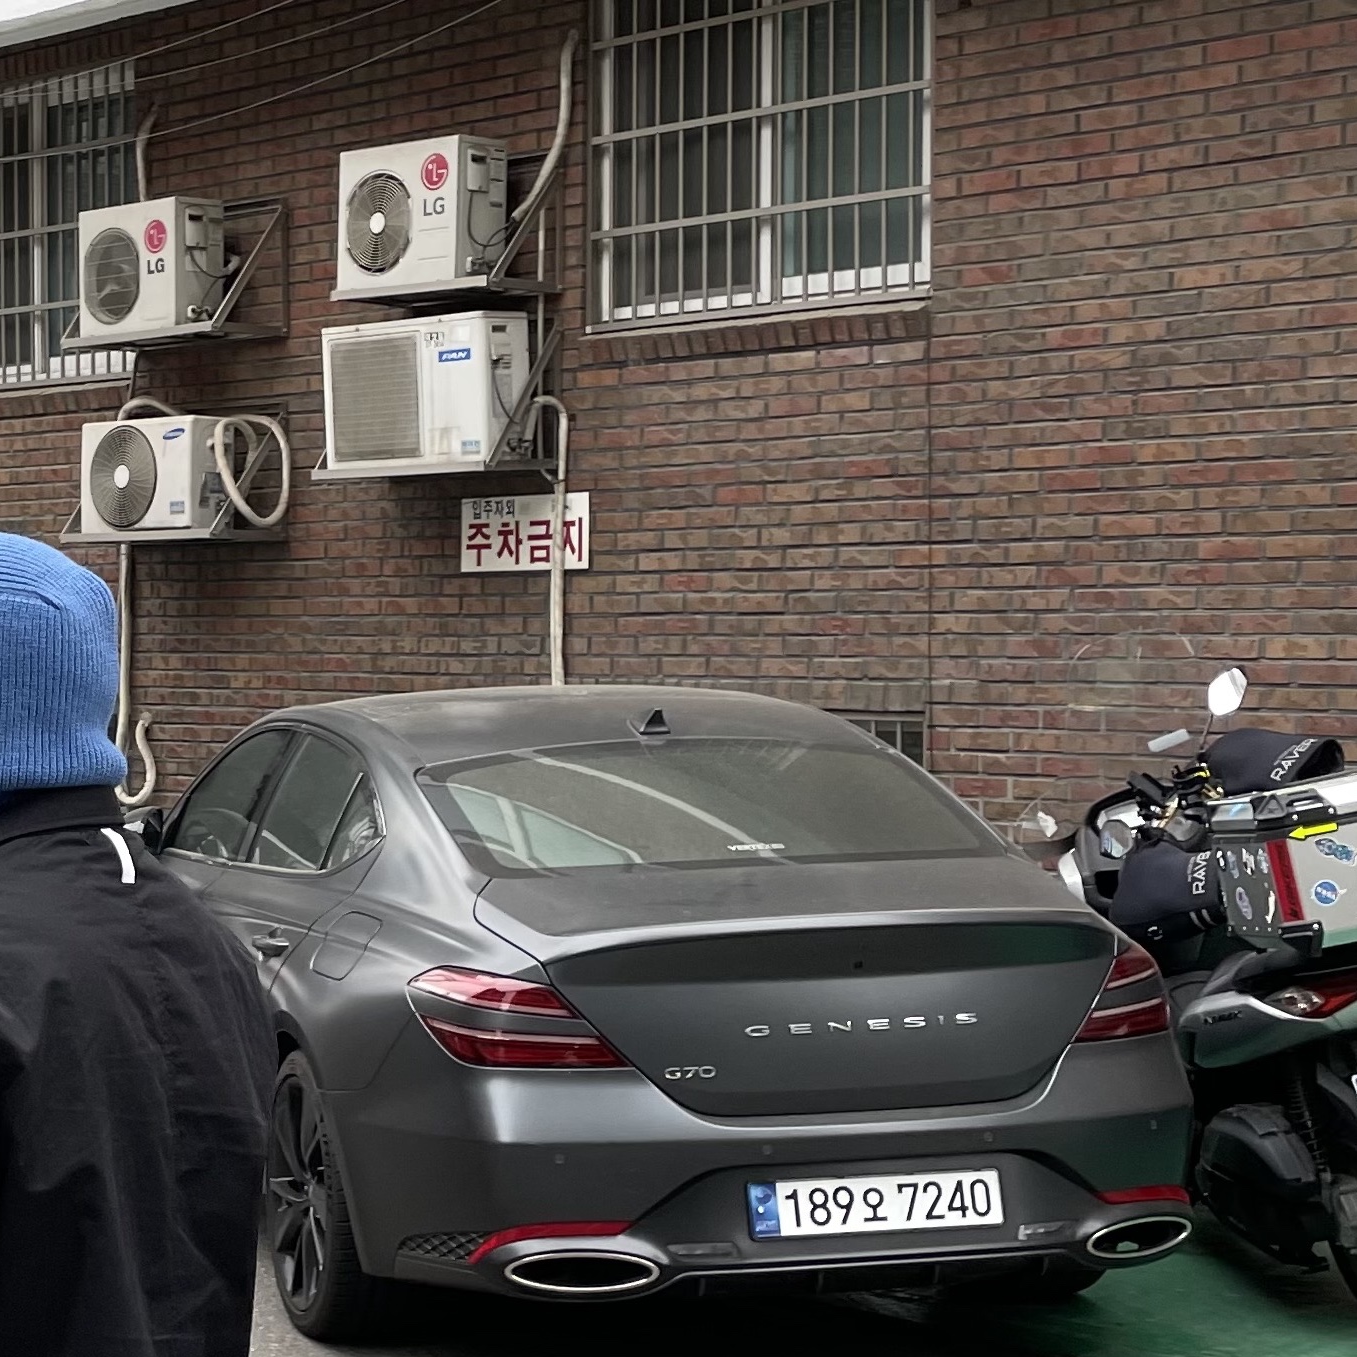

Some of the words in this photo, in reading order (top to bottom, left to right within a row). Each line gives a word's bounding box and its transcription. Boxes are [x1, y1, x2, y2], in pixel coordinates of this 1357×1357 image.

[423, 196, 445, 216] LG
[147, 257, 165, 275] LG
[466, 516, 583, 567] 주차금지
[744, 1012, 979, 1037] GENESIS
[664, 1065, 717, 1080] G70
[784, 1185, 889, 1228] 189오
[896, 1178, 992, 1222] 7240
